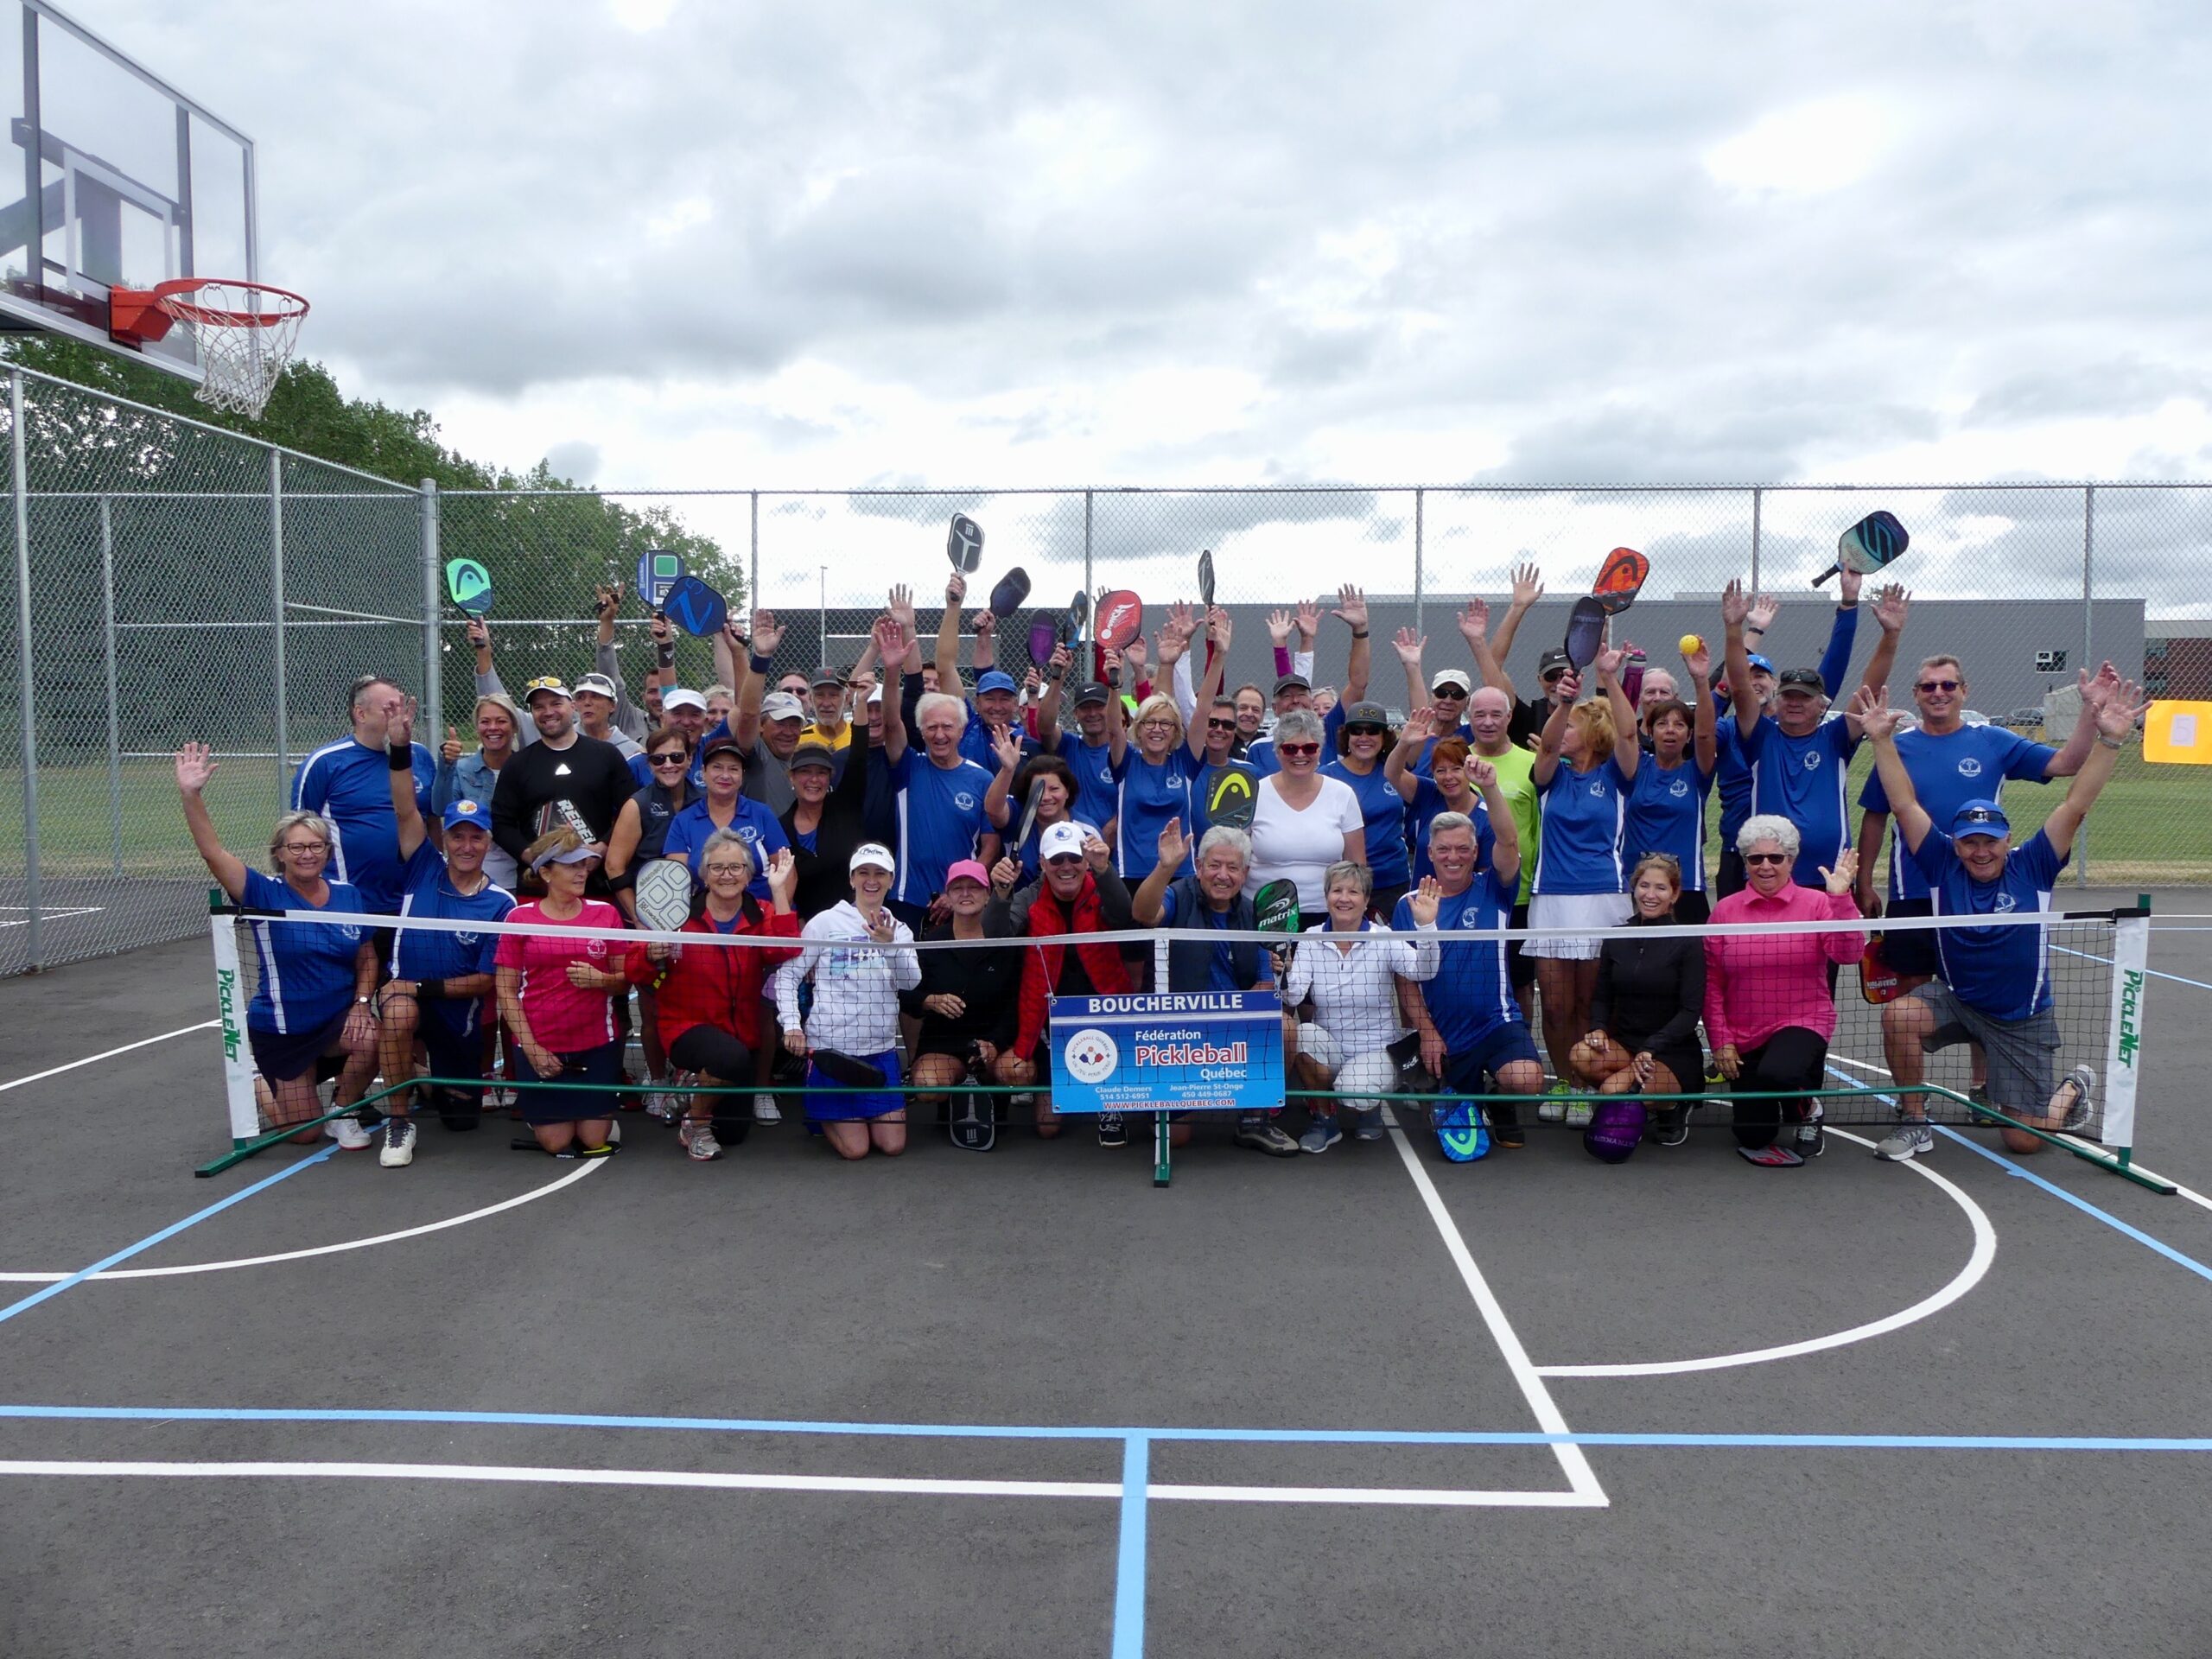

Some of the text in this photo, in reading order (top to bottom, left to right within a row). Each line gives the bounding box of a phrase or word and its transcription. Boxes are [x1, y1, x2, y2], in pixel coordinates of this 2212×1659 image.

[2172, 716, 2192, 742] 5
[556, 799, 596, 844] REBEL
[1258, 908, 1296, 928] matrix
[1089, 994, 1243, 1013] BOUCHERVILLE
[1135, 1029, 1201, 1041] Fédération
[1135, 1042, 1247, 1066] Pickleball
[1200, 1068, 1247, 1081] Québec
[1213, 1083, 1244, 1091] St-Onge
[1103, 1099, 1236, 1109] WWW.PICKLEBALLQUEBEC.COM
